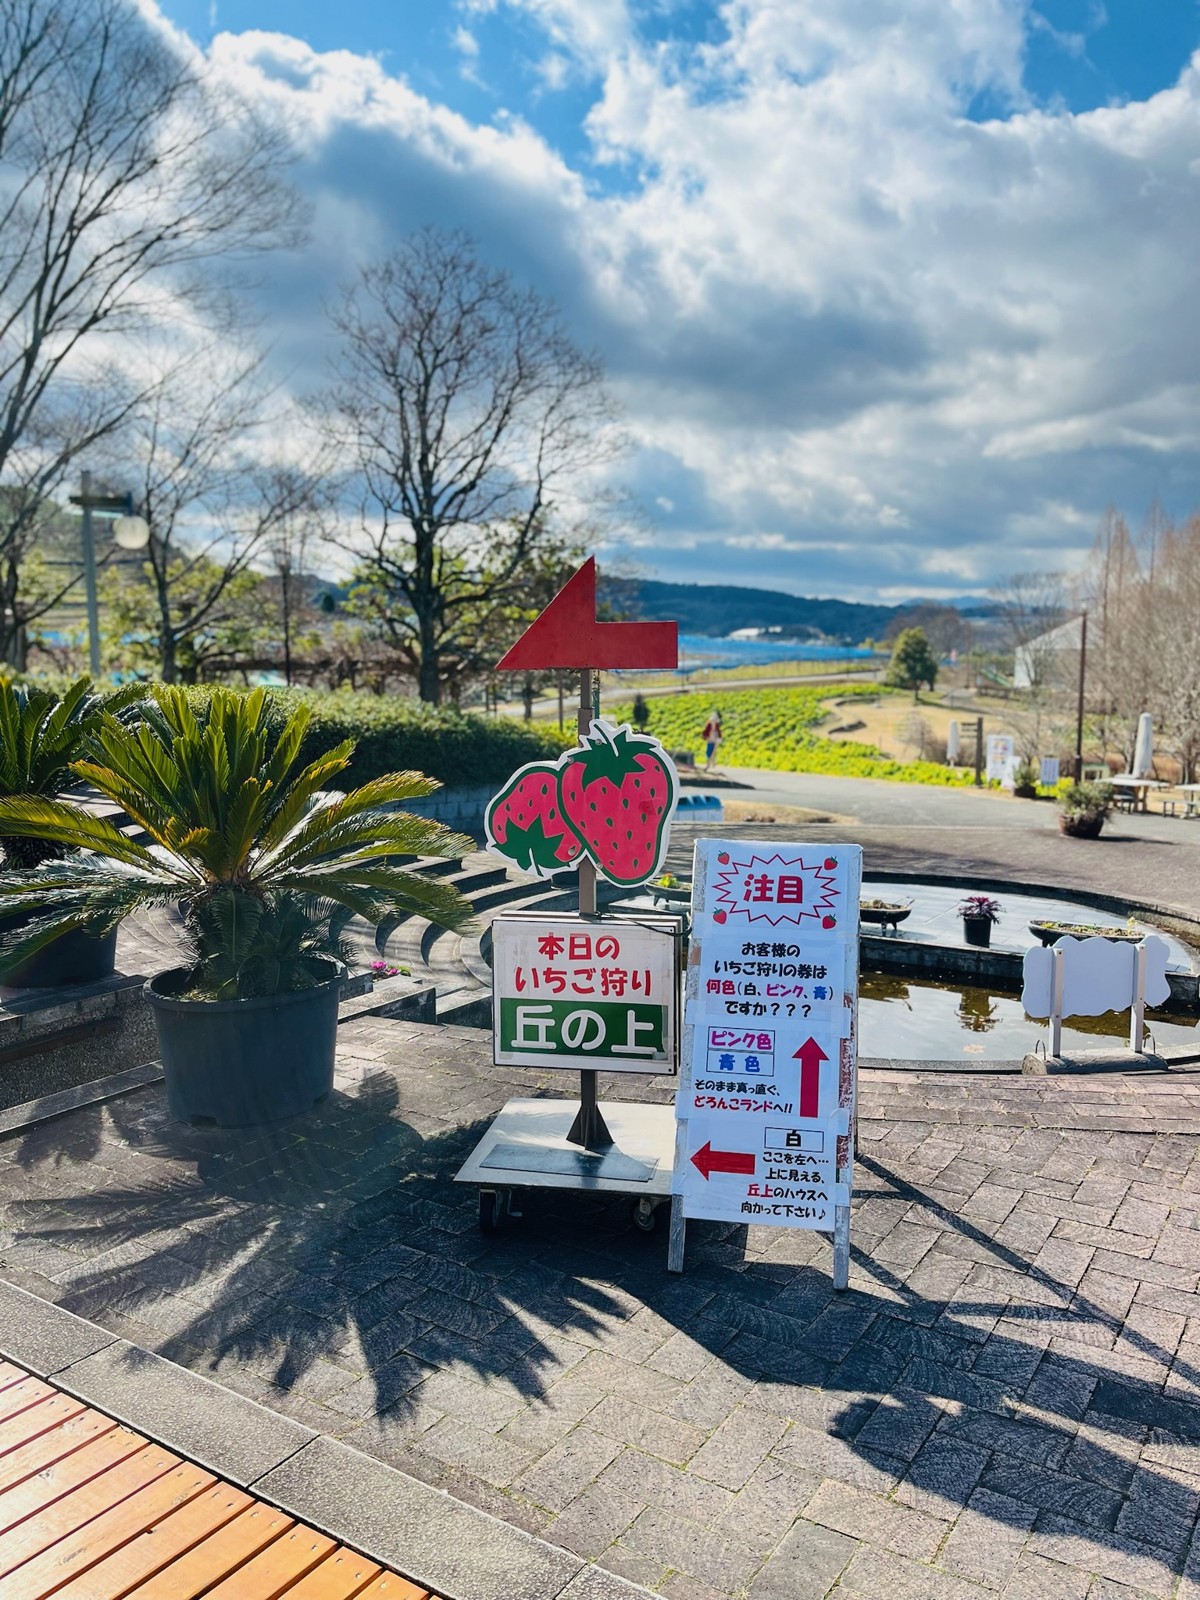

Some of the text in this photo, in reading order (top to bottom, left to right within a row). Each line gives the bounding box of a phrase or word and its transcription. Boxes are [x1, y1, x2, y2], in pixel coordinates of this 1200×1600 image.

[743, 873, 803, 904] 注目
[537, 932, 620, 960] 本日の
[741, 942, 800, 958] お客様の
[714, 960, 827, 979] いちご狩りの券は
[515, 966, 651, 997] いちご狩り
[511, 1004, 658, 1055] 丘の上
[711, 1030, 772, 1050] ピンク色
[694, 1079, 781, 1097] そのまま真っ直ぐ、
[785, 1129, 802, 1147] 白
[765, 1167, 825, 1184] 上に見える、
[747, 1183, 829, 1201] 丘上のハウスへ
